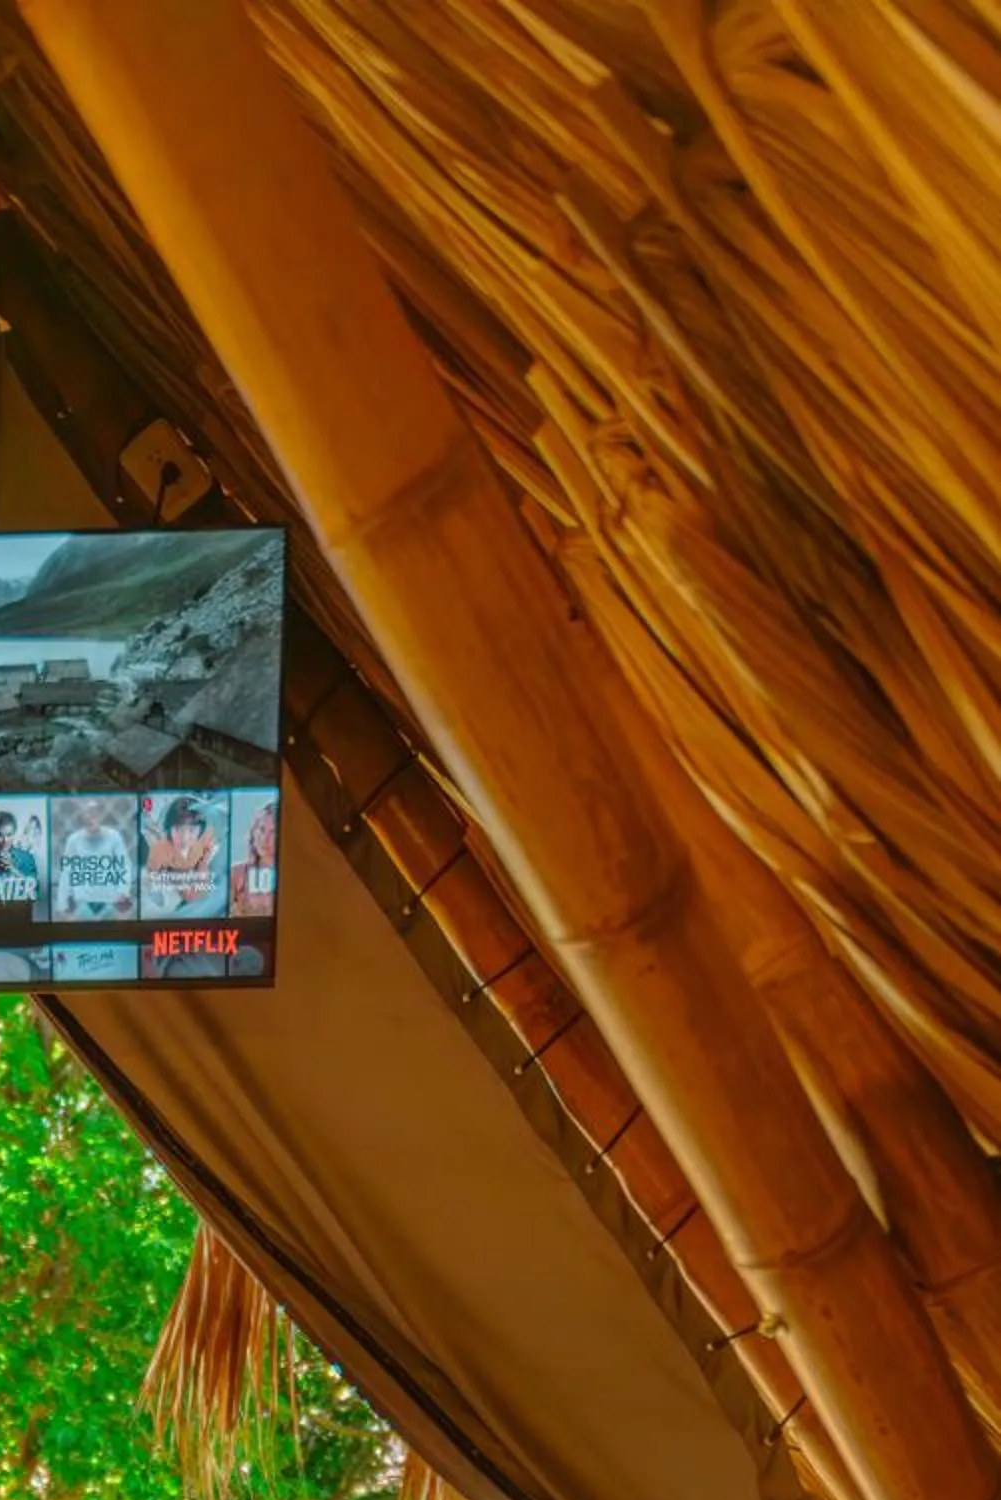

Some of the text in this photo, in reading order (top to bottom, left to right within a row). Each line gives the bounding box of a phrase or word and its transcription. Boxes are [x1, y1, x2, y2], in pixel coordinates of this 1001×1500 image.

[60, 855, 126, 873] PRISON
[70, 870, 128, 888] BREAK
[154, 929, 239, 956] NETFLIX
